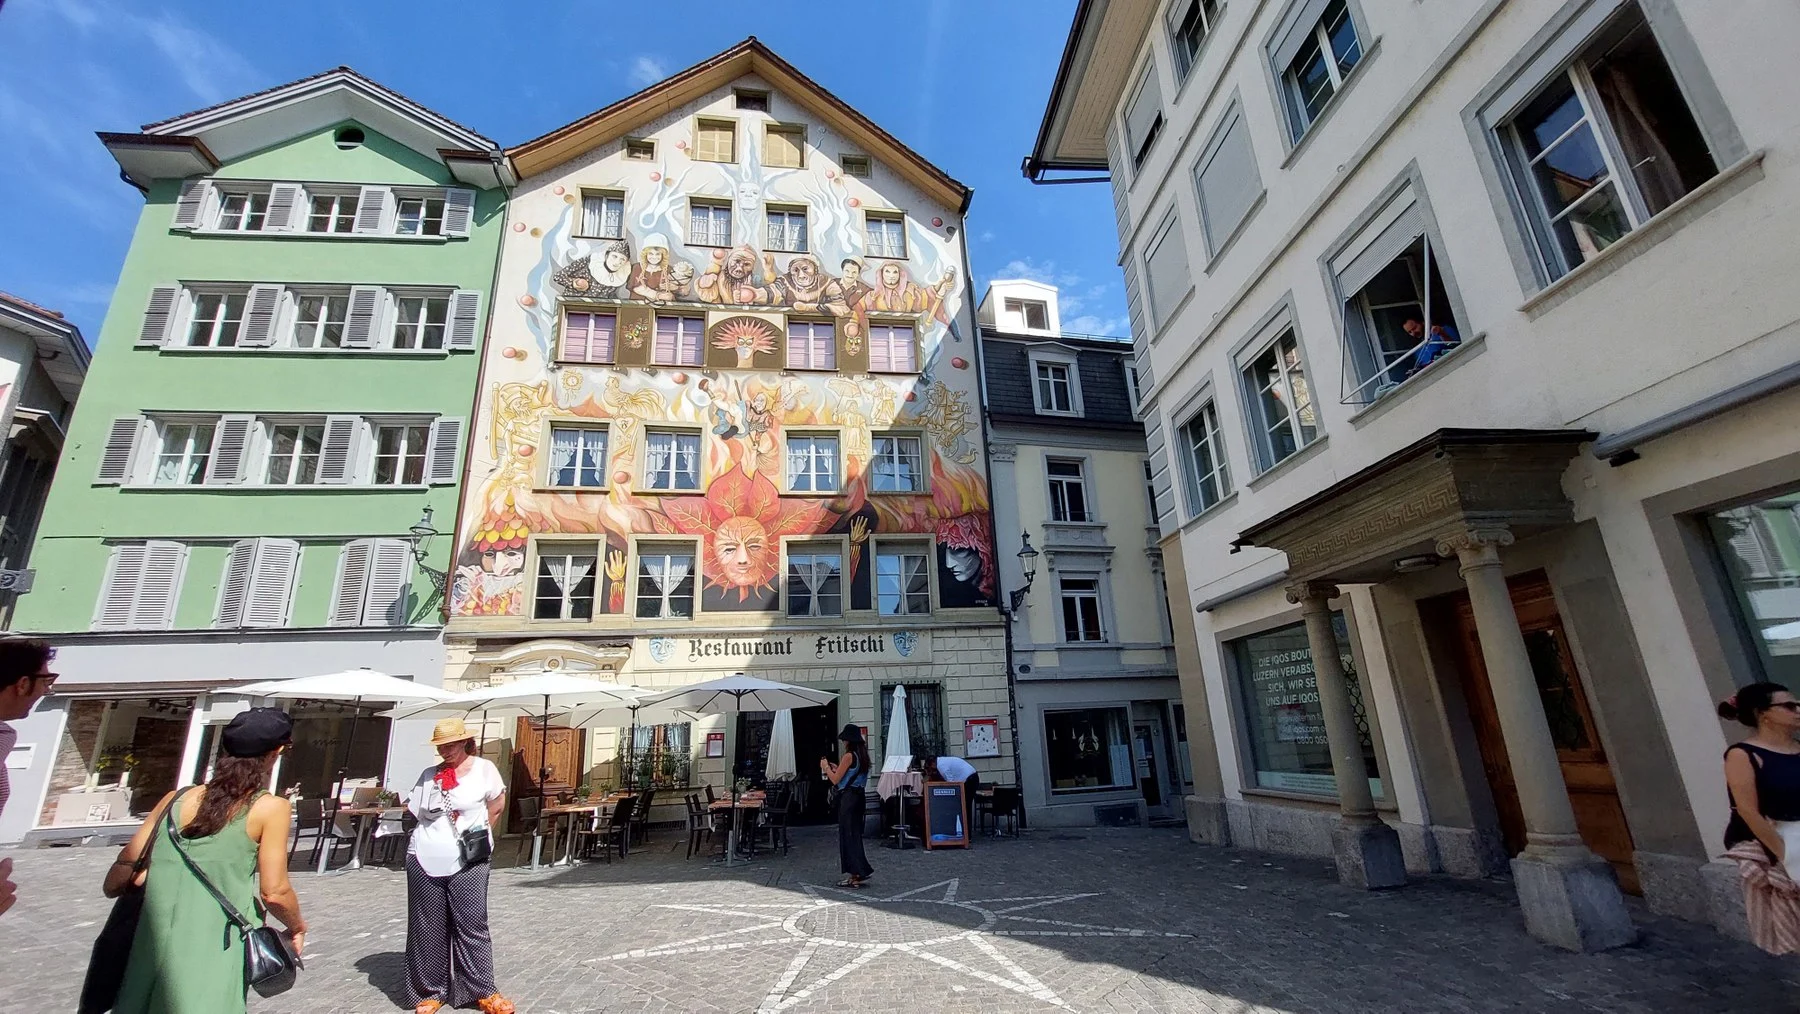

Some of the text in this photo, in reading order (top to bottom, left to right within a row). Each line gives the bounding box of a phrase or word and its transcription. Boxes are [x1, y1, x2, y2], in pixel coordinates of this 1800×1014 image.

[688, 635, 885, 662] Restaurant Fritschi
[1258, 656, 1270, 667] DIE
[1291, 648, 1312, 661] BOUT
[1252, 663, 1316, 681] LUZERN VERABSC
[1268, 677, 1316, 693] SICH, WIR SE
[1265, 692, 1319, 706] UNS AUF IQOS
